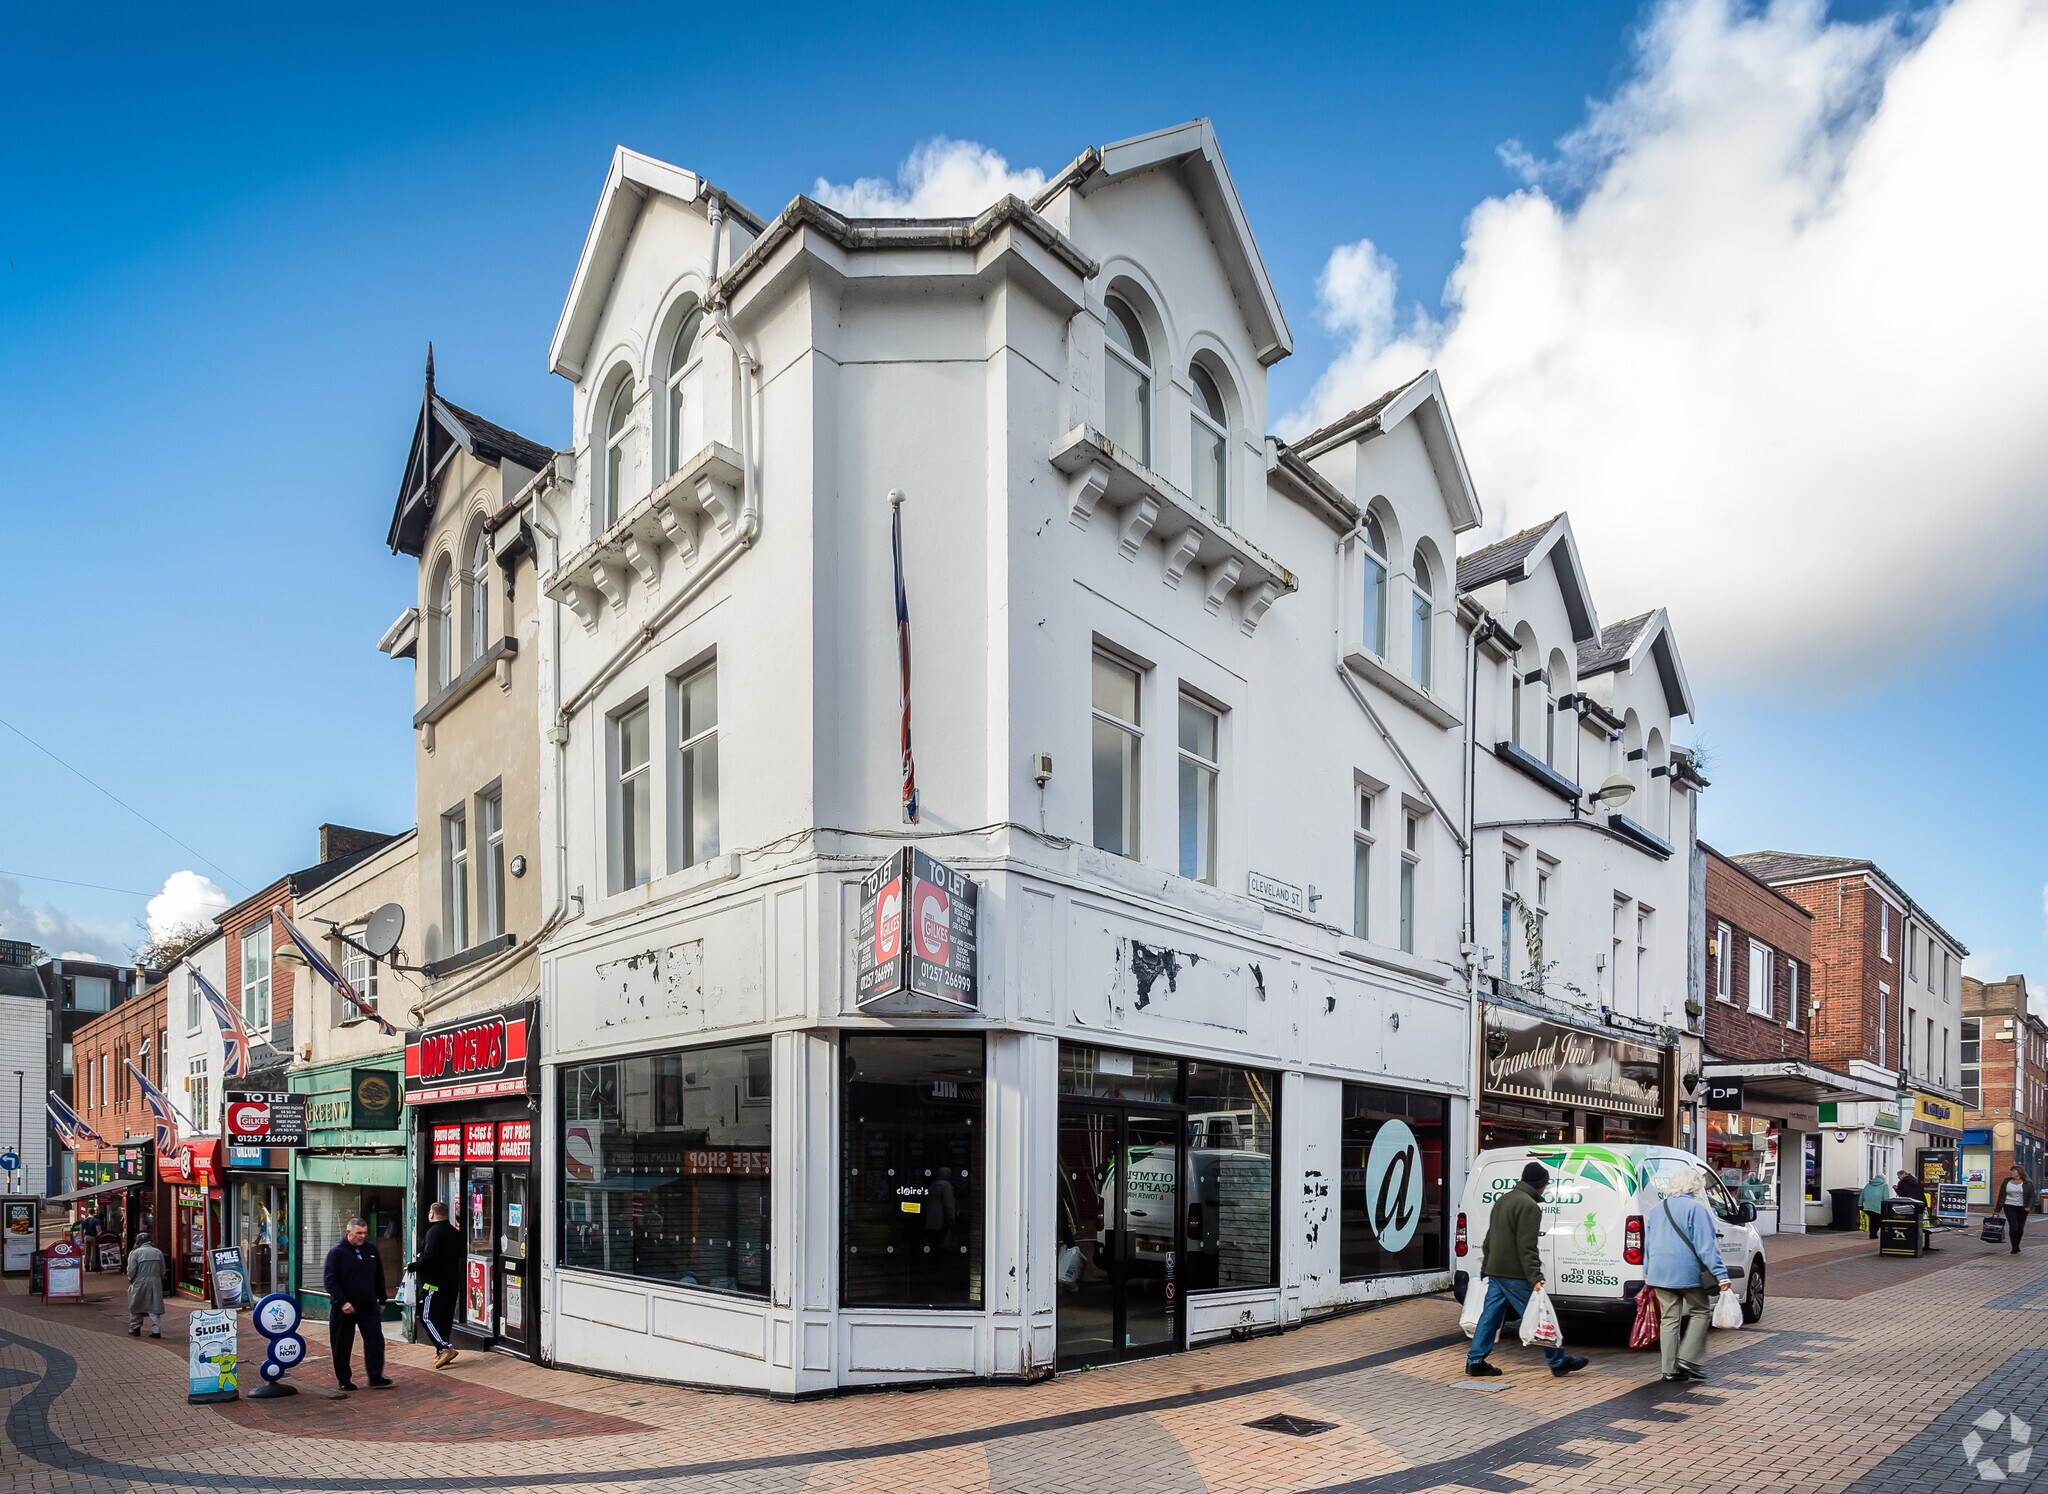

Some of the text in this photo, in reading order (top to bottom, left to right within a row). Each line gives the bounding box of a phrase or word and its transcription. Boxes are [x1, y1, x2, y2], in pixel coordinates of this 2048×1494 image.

[867, 876, 878, 897] TO
[879, 860, 892, 884] LET
[929, 860, 966, 898] TO LET
[1251, 878, 1300, 905] CLEVELAND ST
[883, 914, 900, 937] GILKES
[925, 921, 948, 943] GILKES
[861, 971, 874, 991] 01257
[874, 961, 894, 984] 266999
[921, 962, 971, 992] 01257 266999
[452, 1020, 504, 1074] NEWS
[1488, 1032, 1596, 1090] Grandad Jim's
[244, 1093, 290, 1102] TO LET
[1712, 1088, 1739, 1099] DP
[468, 1126, 486, 1140] E-CIGS
[502, 1126, 514, 1140] CUT
[896, 1186, 928, 1196] claire's
[1492, 1178, 1575, 1190] OLYPIC
[1482, 1192, 1583, 1204] SCOLD
[1541, 1206, 1561, 1214] HIRE
[215, 1250, 239, 1260] SMILE
[1561, 1274, 1618, 1286] 922 8853
[196, 1323, 230, 1336] SLUSH
